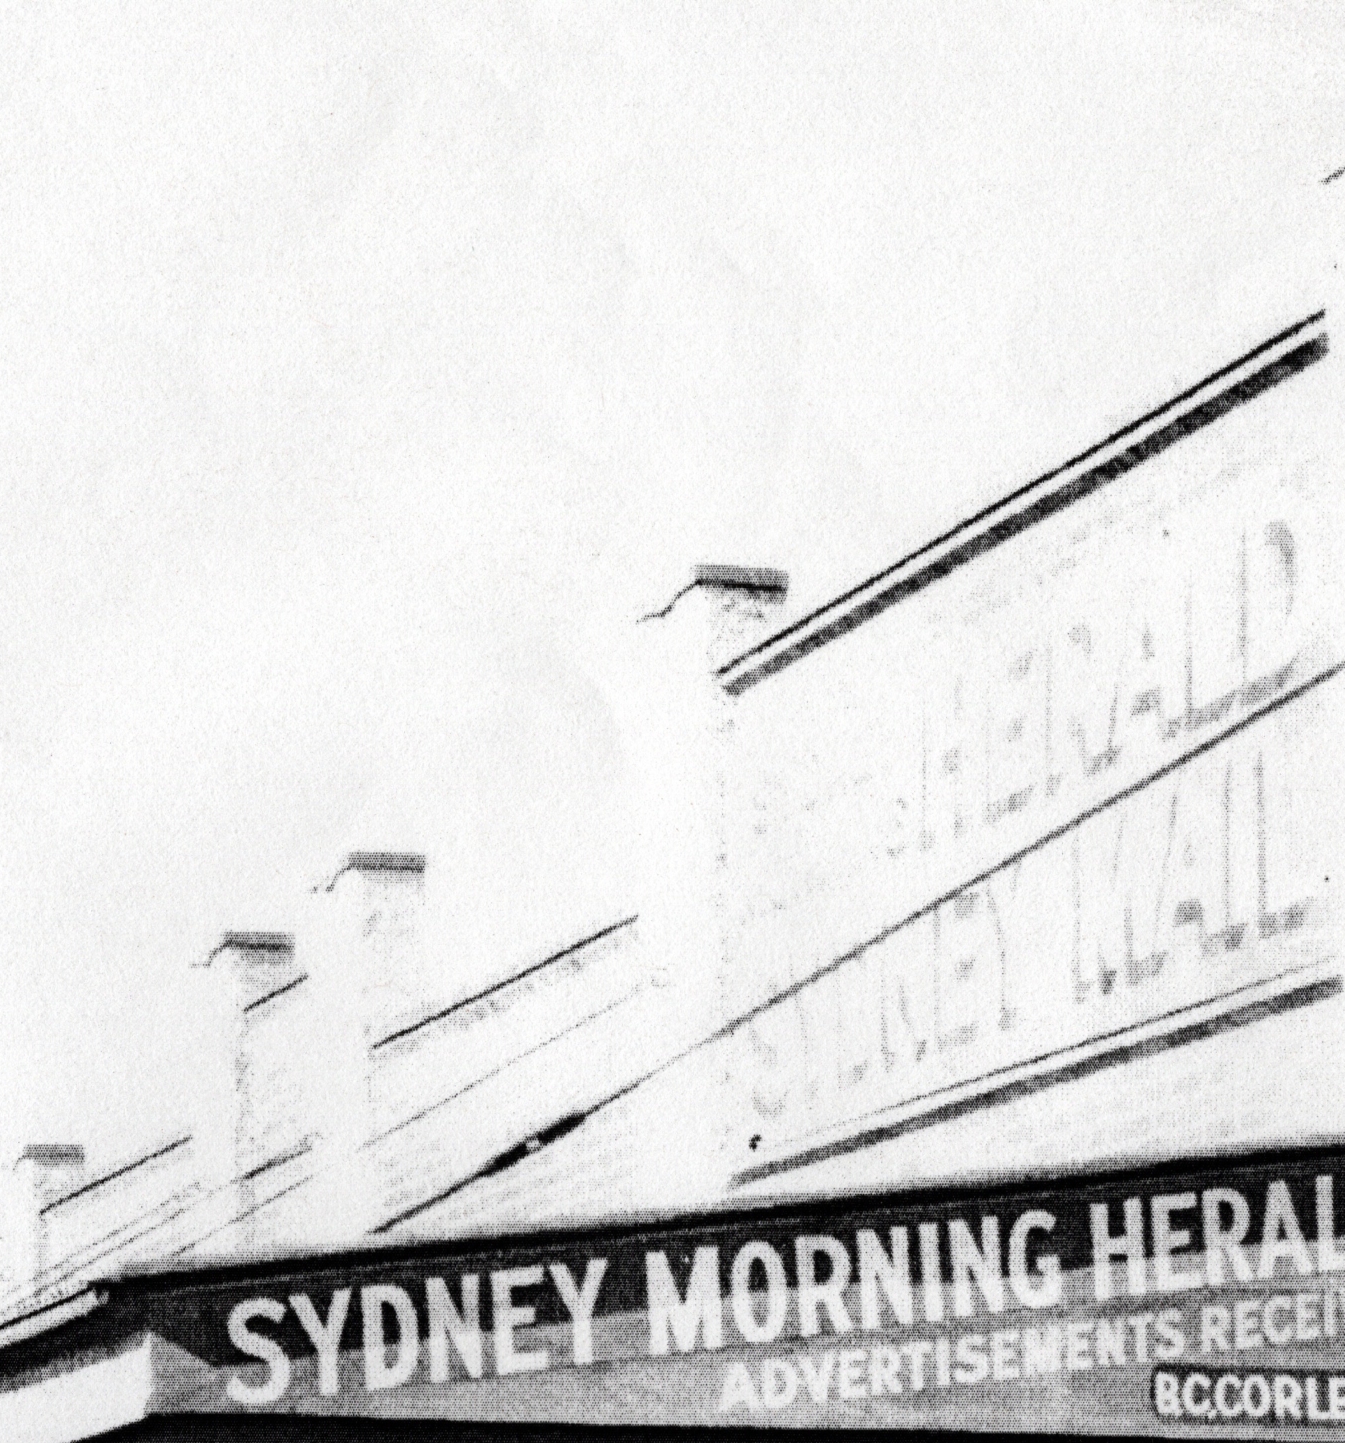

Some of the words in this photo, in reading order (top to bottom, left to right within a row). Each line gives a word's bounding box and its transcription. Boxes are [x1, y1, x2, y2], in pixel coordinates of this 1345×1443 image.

[225, 1258, 607, 1401] SYDNEY
[645, 1210, 1056, 1355] MORNING
[717, 1307, 1185, 1413] ADVERTISEMENTS
